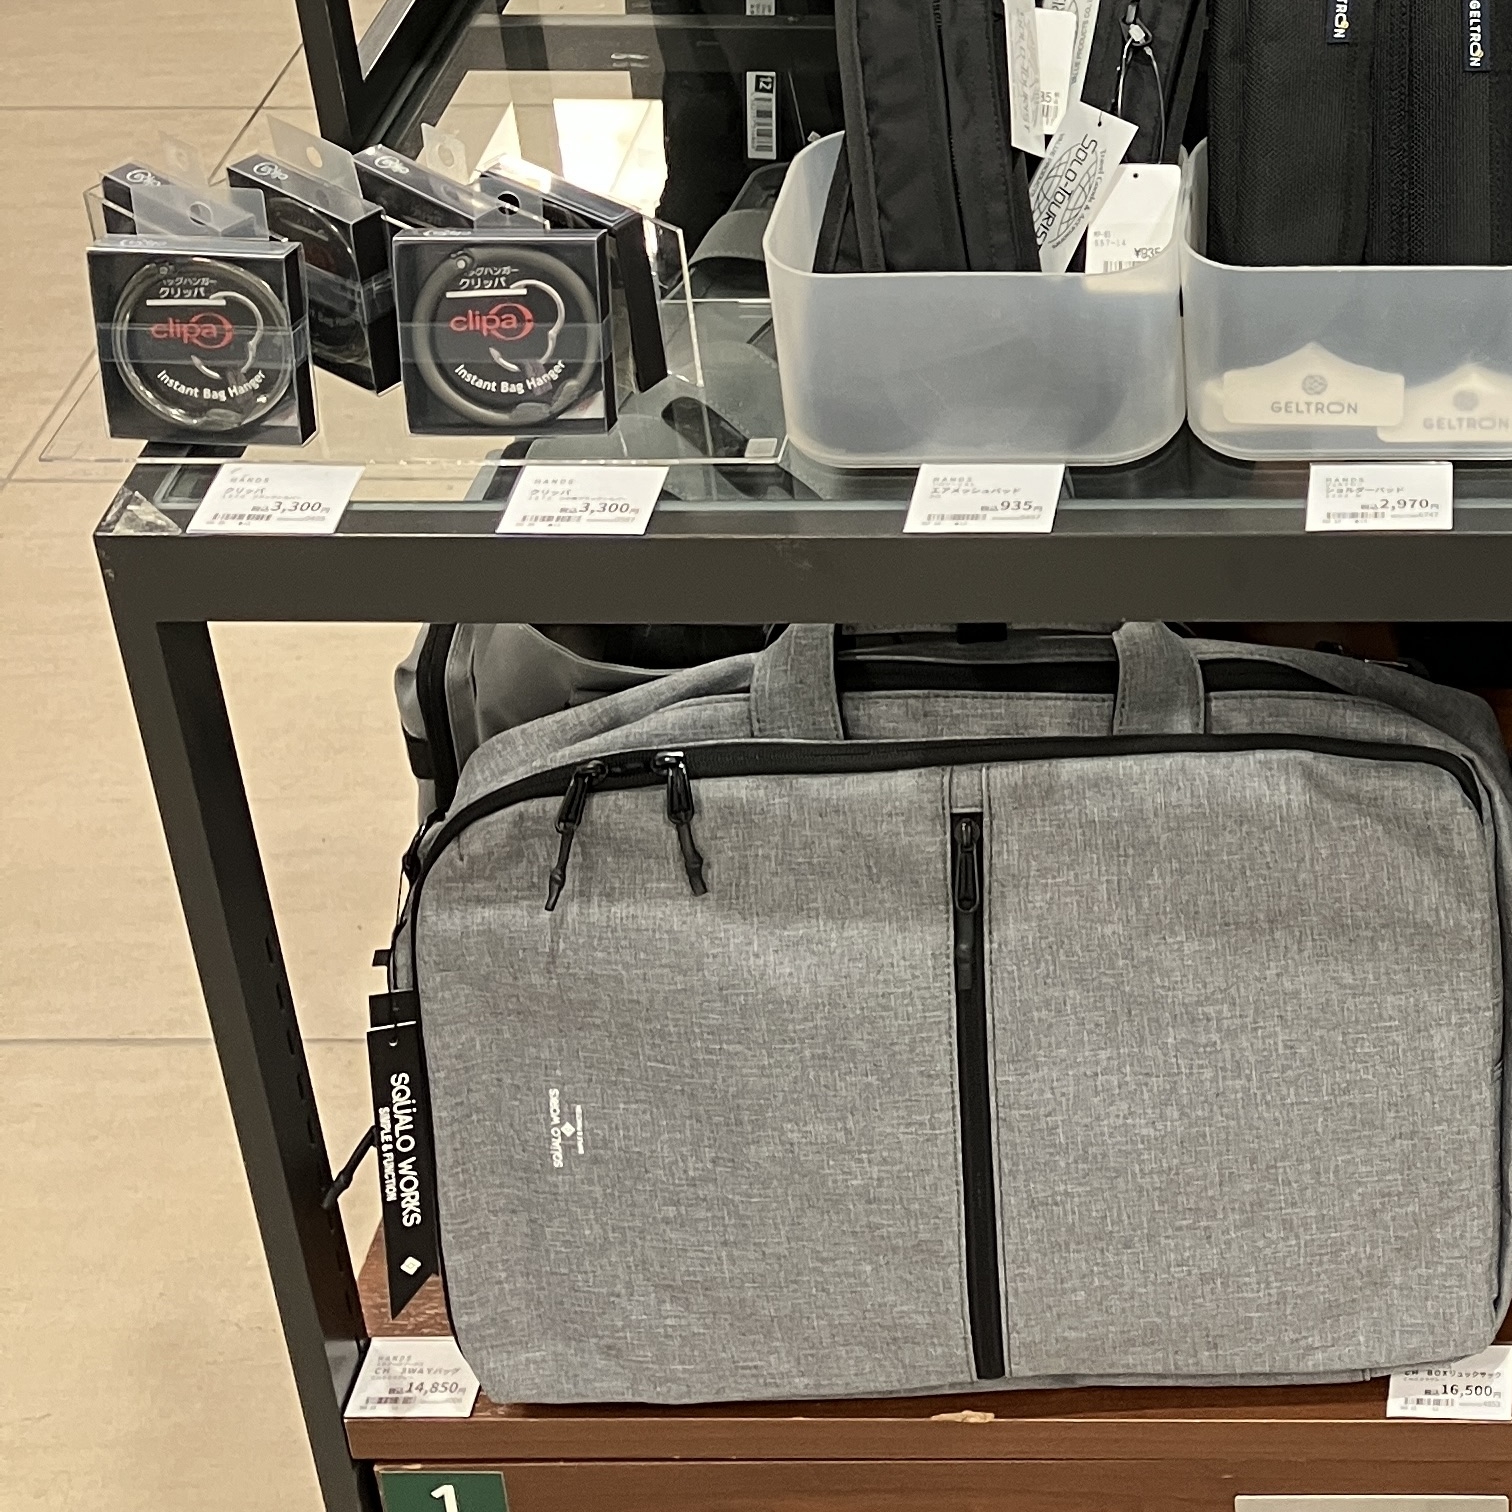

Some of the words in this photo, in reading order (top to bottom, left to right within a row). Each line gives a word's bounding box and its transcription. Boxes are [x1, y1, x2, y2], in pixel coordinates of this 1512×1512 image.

[1469, 0, 1484, 67] GELTRON
[1037, 133, 1098, 246] SOLO-TOURIS
[158, 287, 205, 298] クリッパ
[459, 277, 506, 290] クリッパ
[150, 315, 220, 345] clipa
[449, 307, 519, 338] clipa
[157, 369, 199, 398] Instant
[203, 388, 227, 402] Bag
[227, 370, 266, 398] Hanger
[454, 364, 497, 392] Instant
[500, 381, 525, 395] Bag
[525, 359, 566, 390] Hanger
[1271, 401, 1358, 414] GELTRON
[1422, 417, 1509, 430] GELTRON
[378, 1106, 393, 1144] SIMPLE
[382, 1154, 397, 1202] FUNCTION
[398, 1156, 422, 1228] WORKS
[430, 1484, 459, 1512] 1
